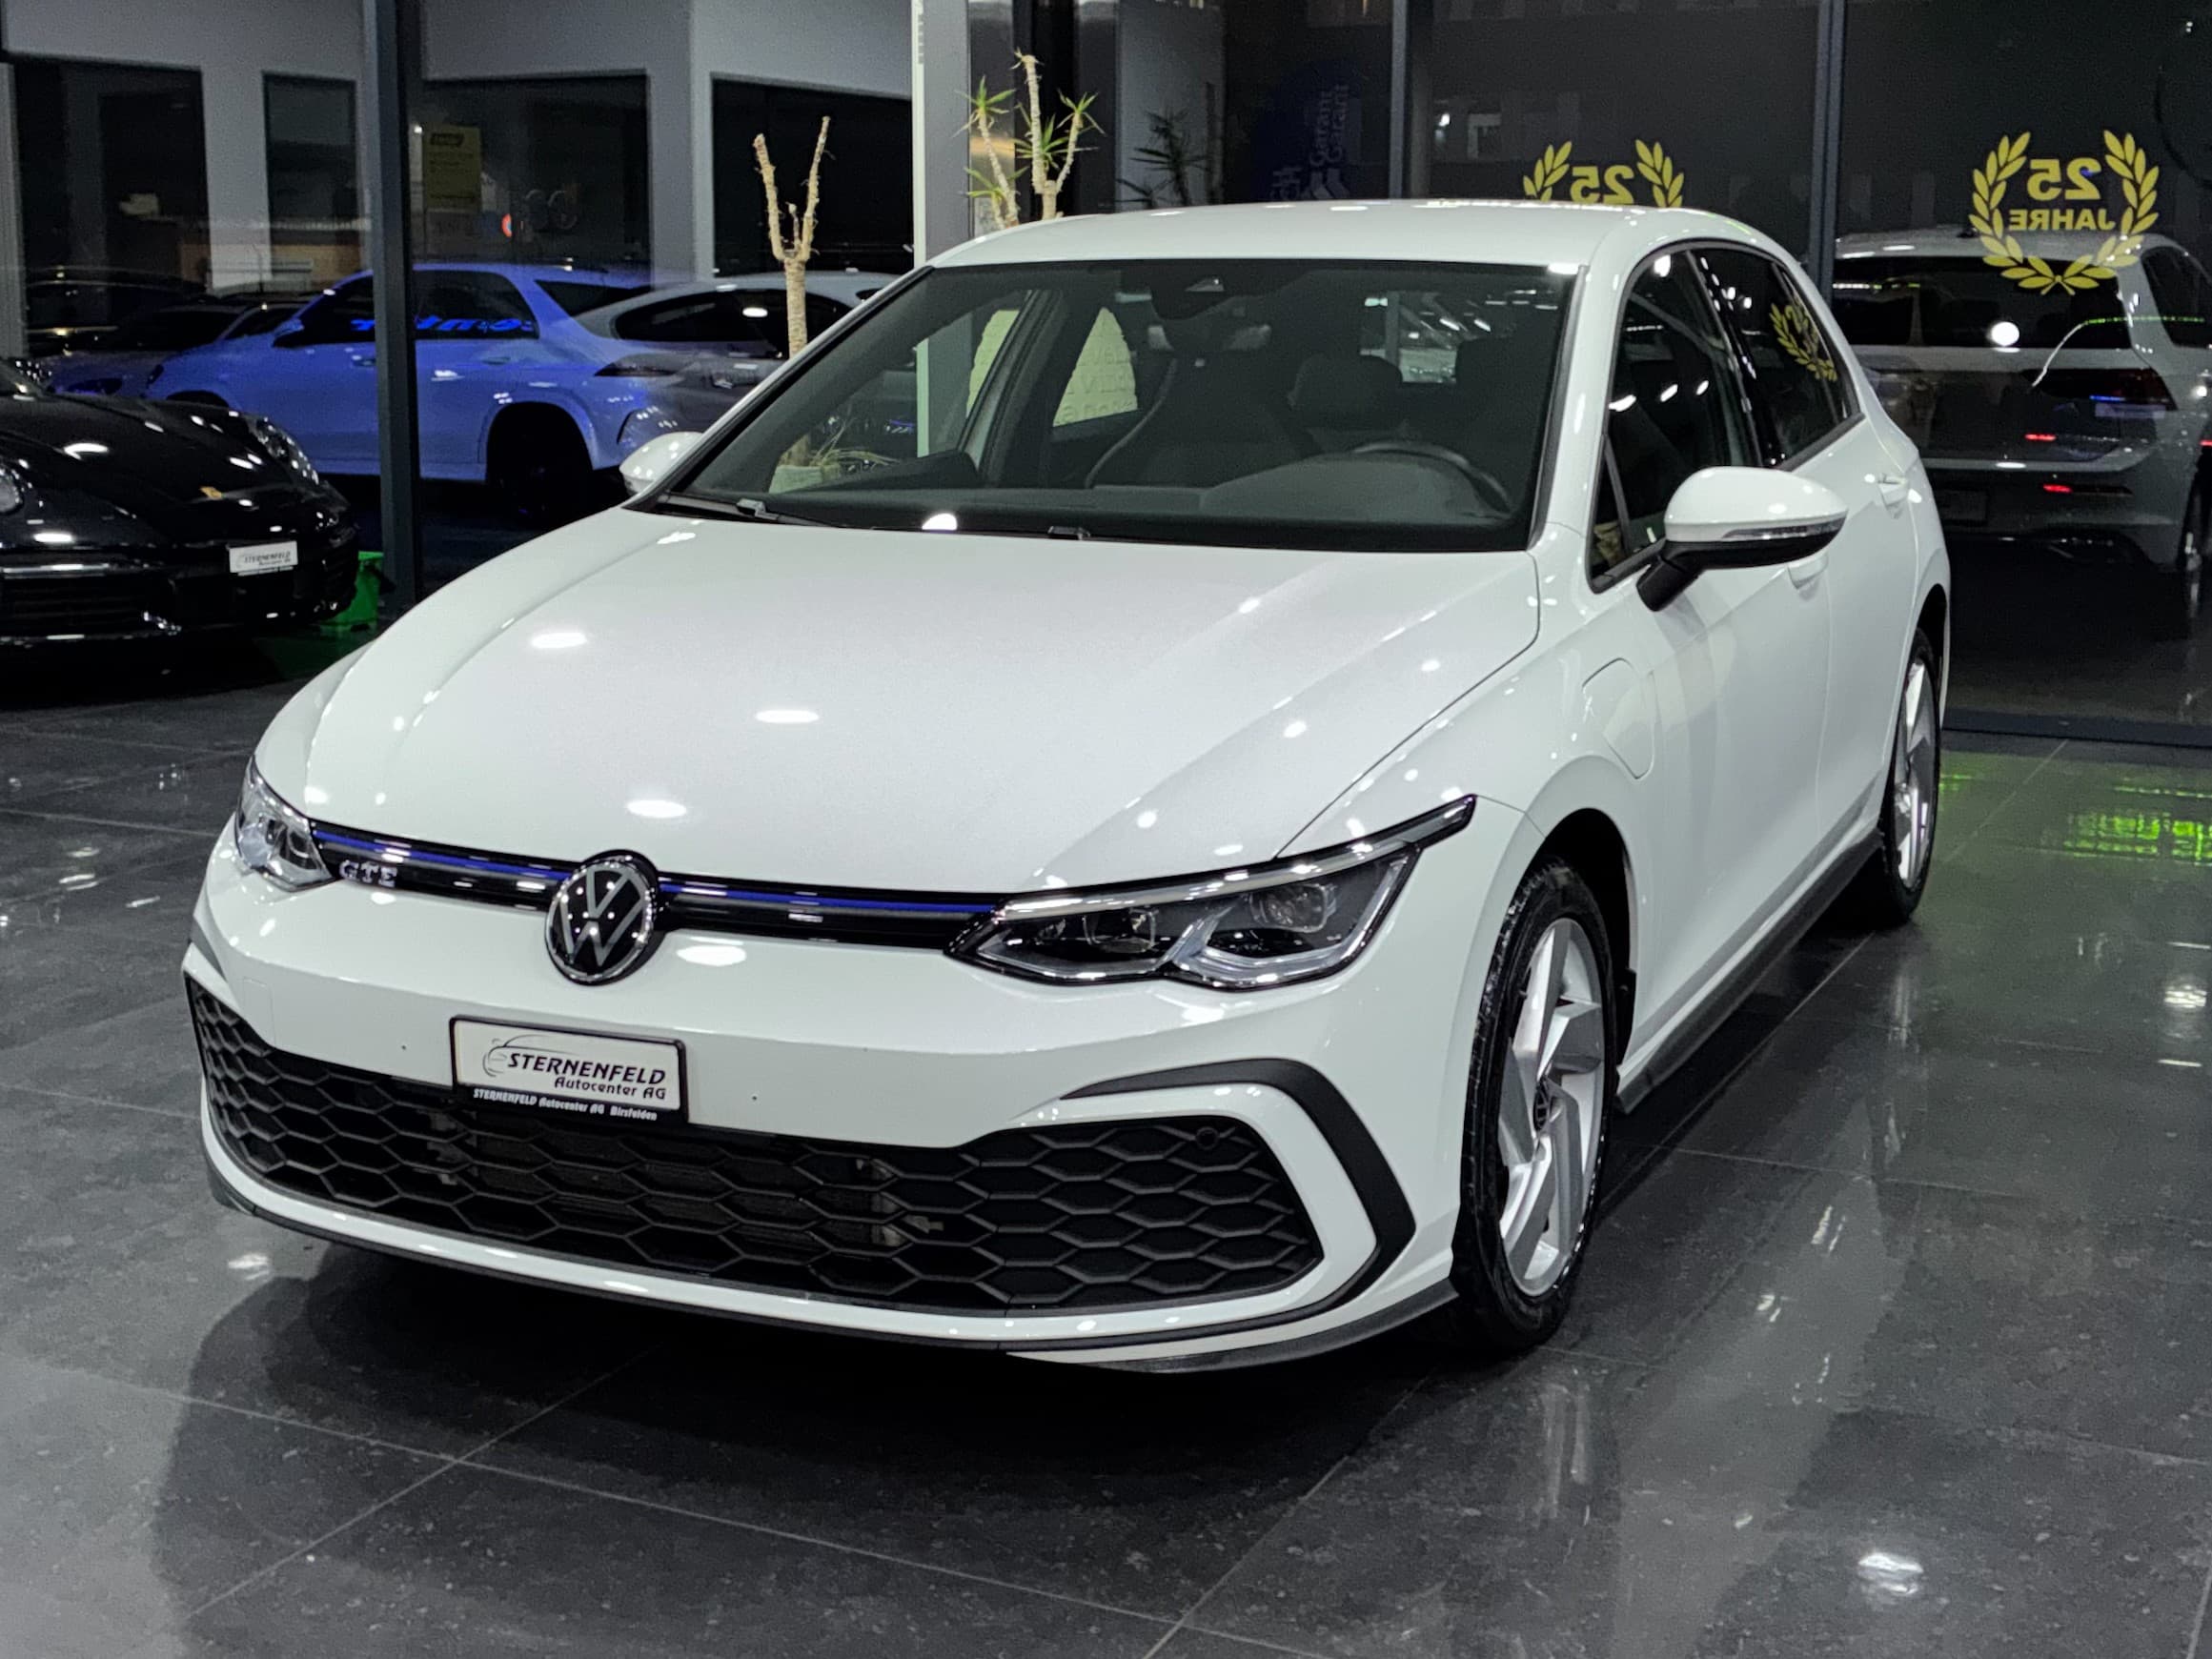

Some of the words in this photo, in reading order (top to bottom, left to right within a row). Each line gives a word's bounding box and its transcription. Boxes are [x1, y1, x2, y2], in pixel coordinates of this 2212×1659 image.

[338, 860, 398, 888] GTE
[508, 1052, 666, 1085] STERNENFELD
[554, 1075, 638, 1097] Autocenter
[642, 1086, 666, 1100] AG
[473, 1087, 538, 1106] STERNENFELD
[538, 1097, 588, 1113] Autocenter
[589, 1103, 605, 1115] AG
[609, 1105, 658, 1122] Birsfelden
